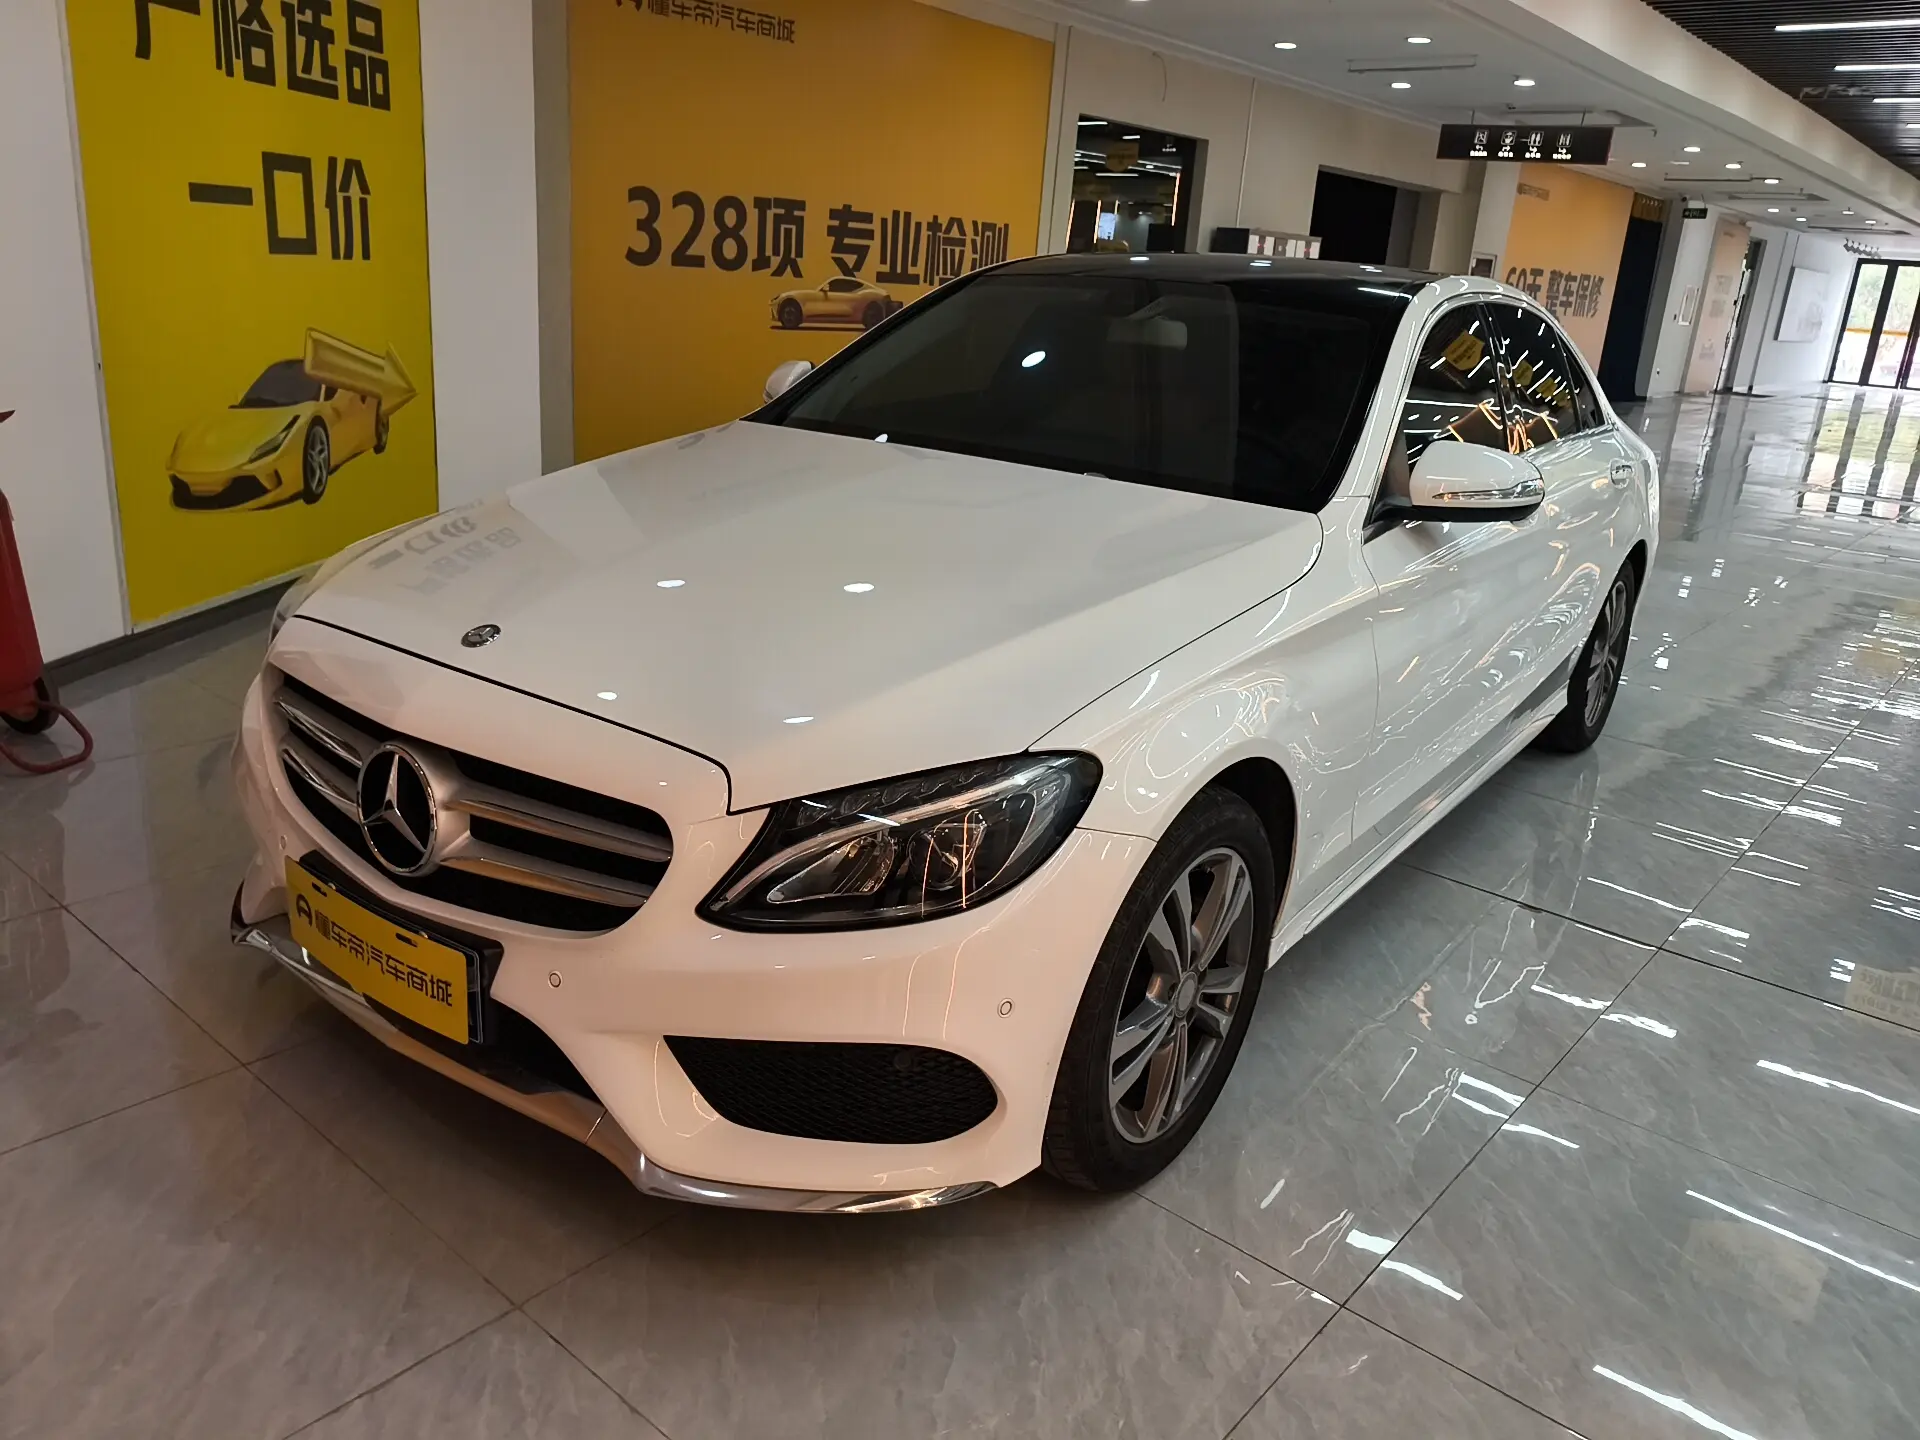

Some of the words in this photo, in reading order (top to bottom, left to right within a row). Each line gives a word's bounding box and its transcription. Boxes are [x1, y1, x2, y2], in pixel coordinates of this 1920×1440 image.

[188, 151, 371, 260] 一口价
[625, 185, 806, 279] 328项
[826, 204, 1010, 286] 专业检测
[315, 909, 453, 1007] 懂车帝汽车商城
